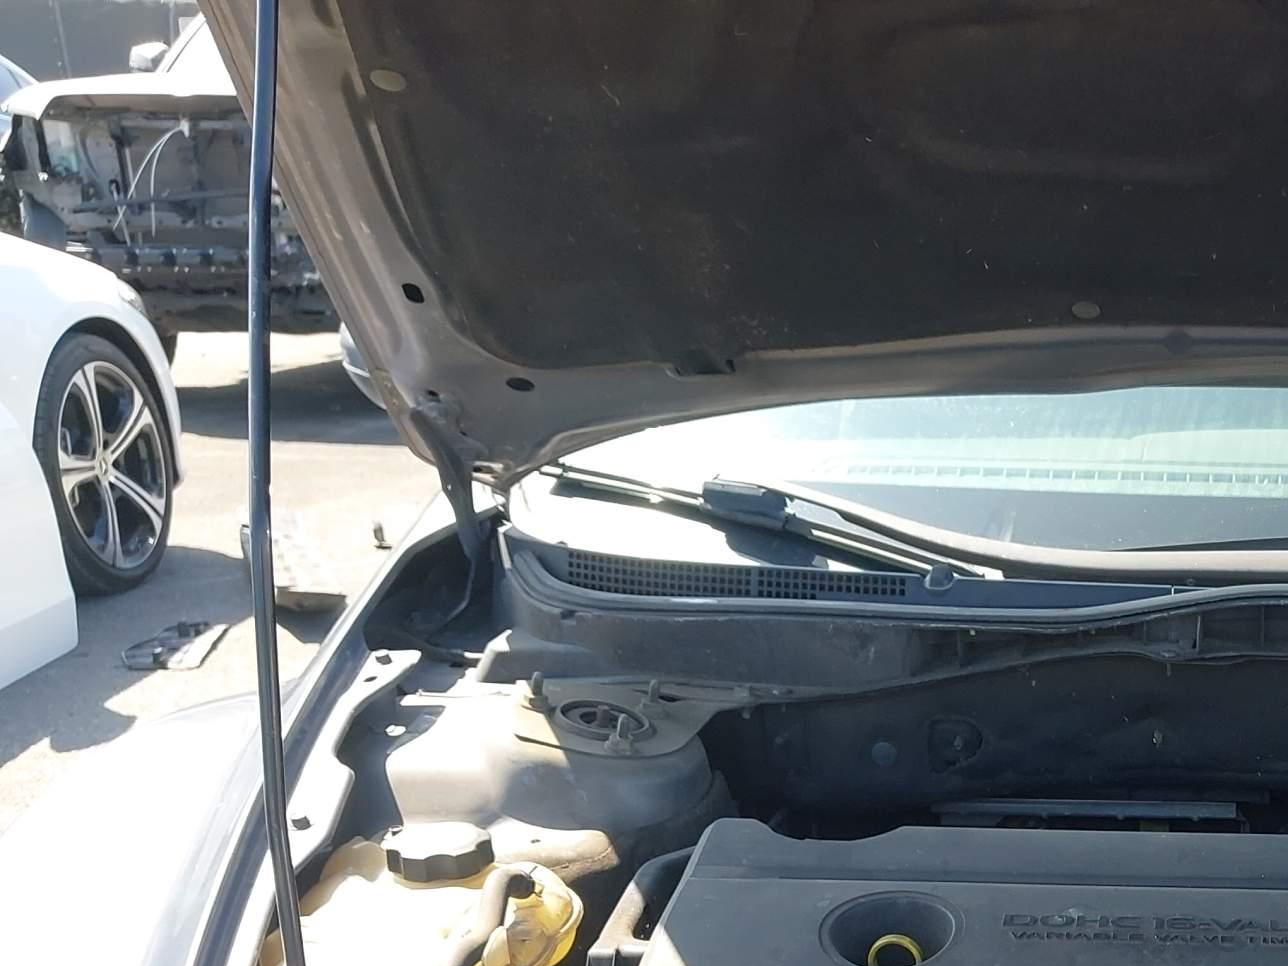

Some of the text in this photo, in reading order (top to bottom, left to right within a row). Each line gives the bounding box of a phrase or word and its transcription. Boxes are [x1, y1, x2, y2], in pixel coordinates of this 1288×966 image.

[1002, 913, 1145, 929] DOHC
[1010, 930, 1146, 942] VARIABLE
[1154, 934, 1236, 945] VALVE
